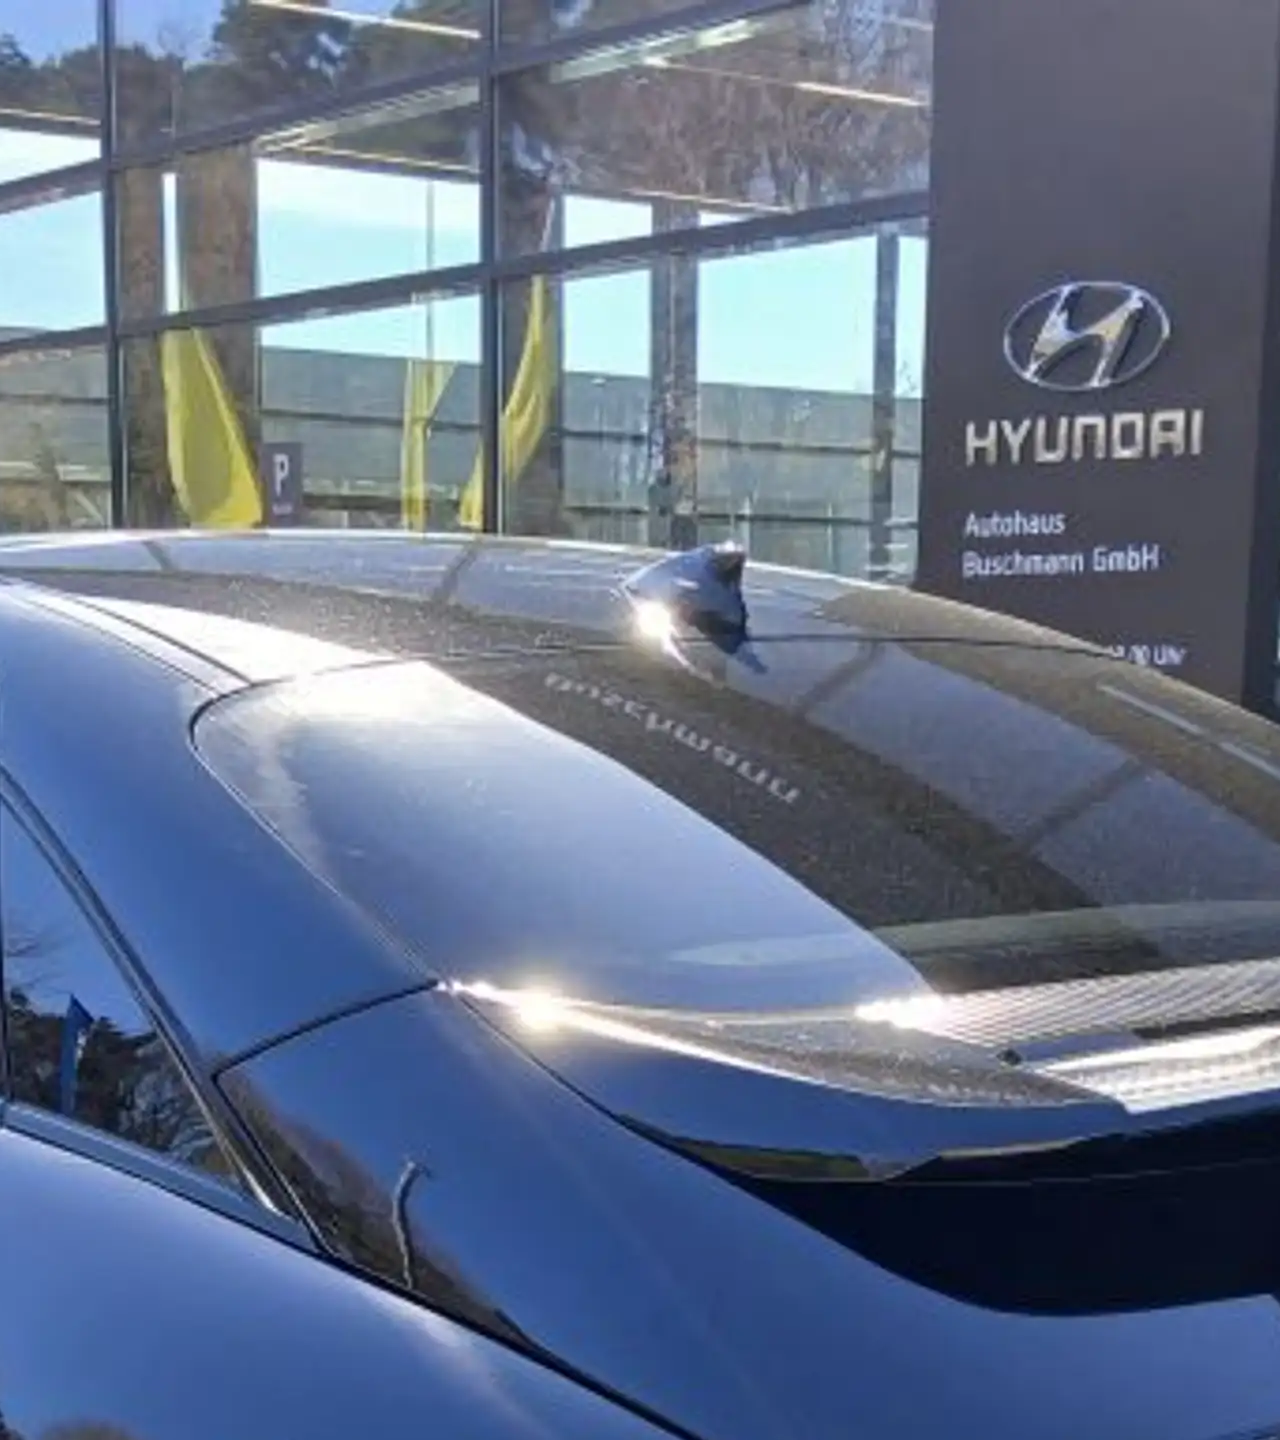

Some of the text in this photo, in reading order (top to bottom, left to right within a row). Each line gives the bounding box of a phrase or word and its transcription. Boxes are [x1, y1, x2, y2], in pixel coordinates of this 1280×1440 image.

[966, 409, 1204, 467] HYUNDAI
[273, 452, 290, 497] P
[965, 510, 1067, 539] Autohaus
[963, 544, 1161, 579] Buschmann GmbH
